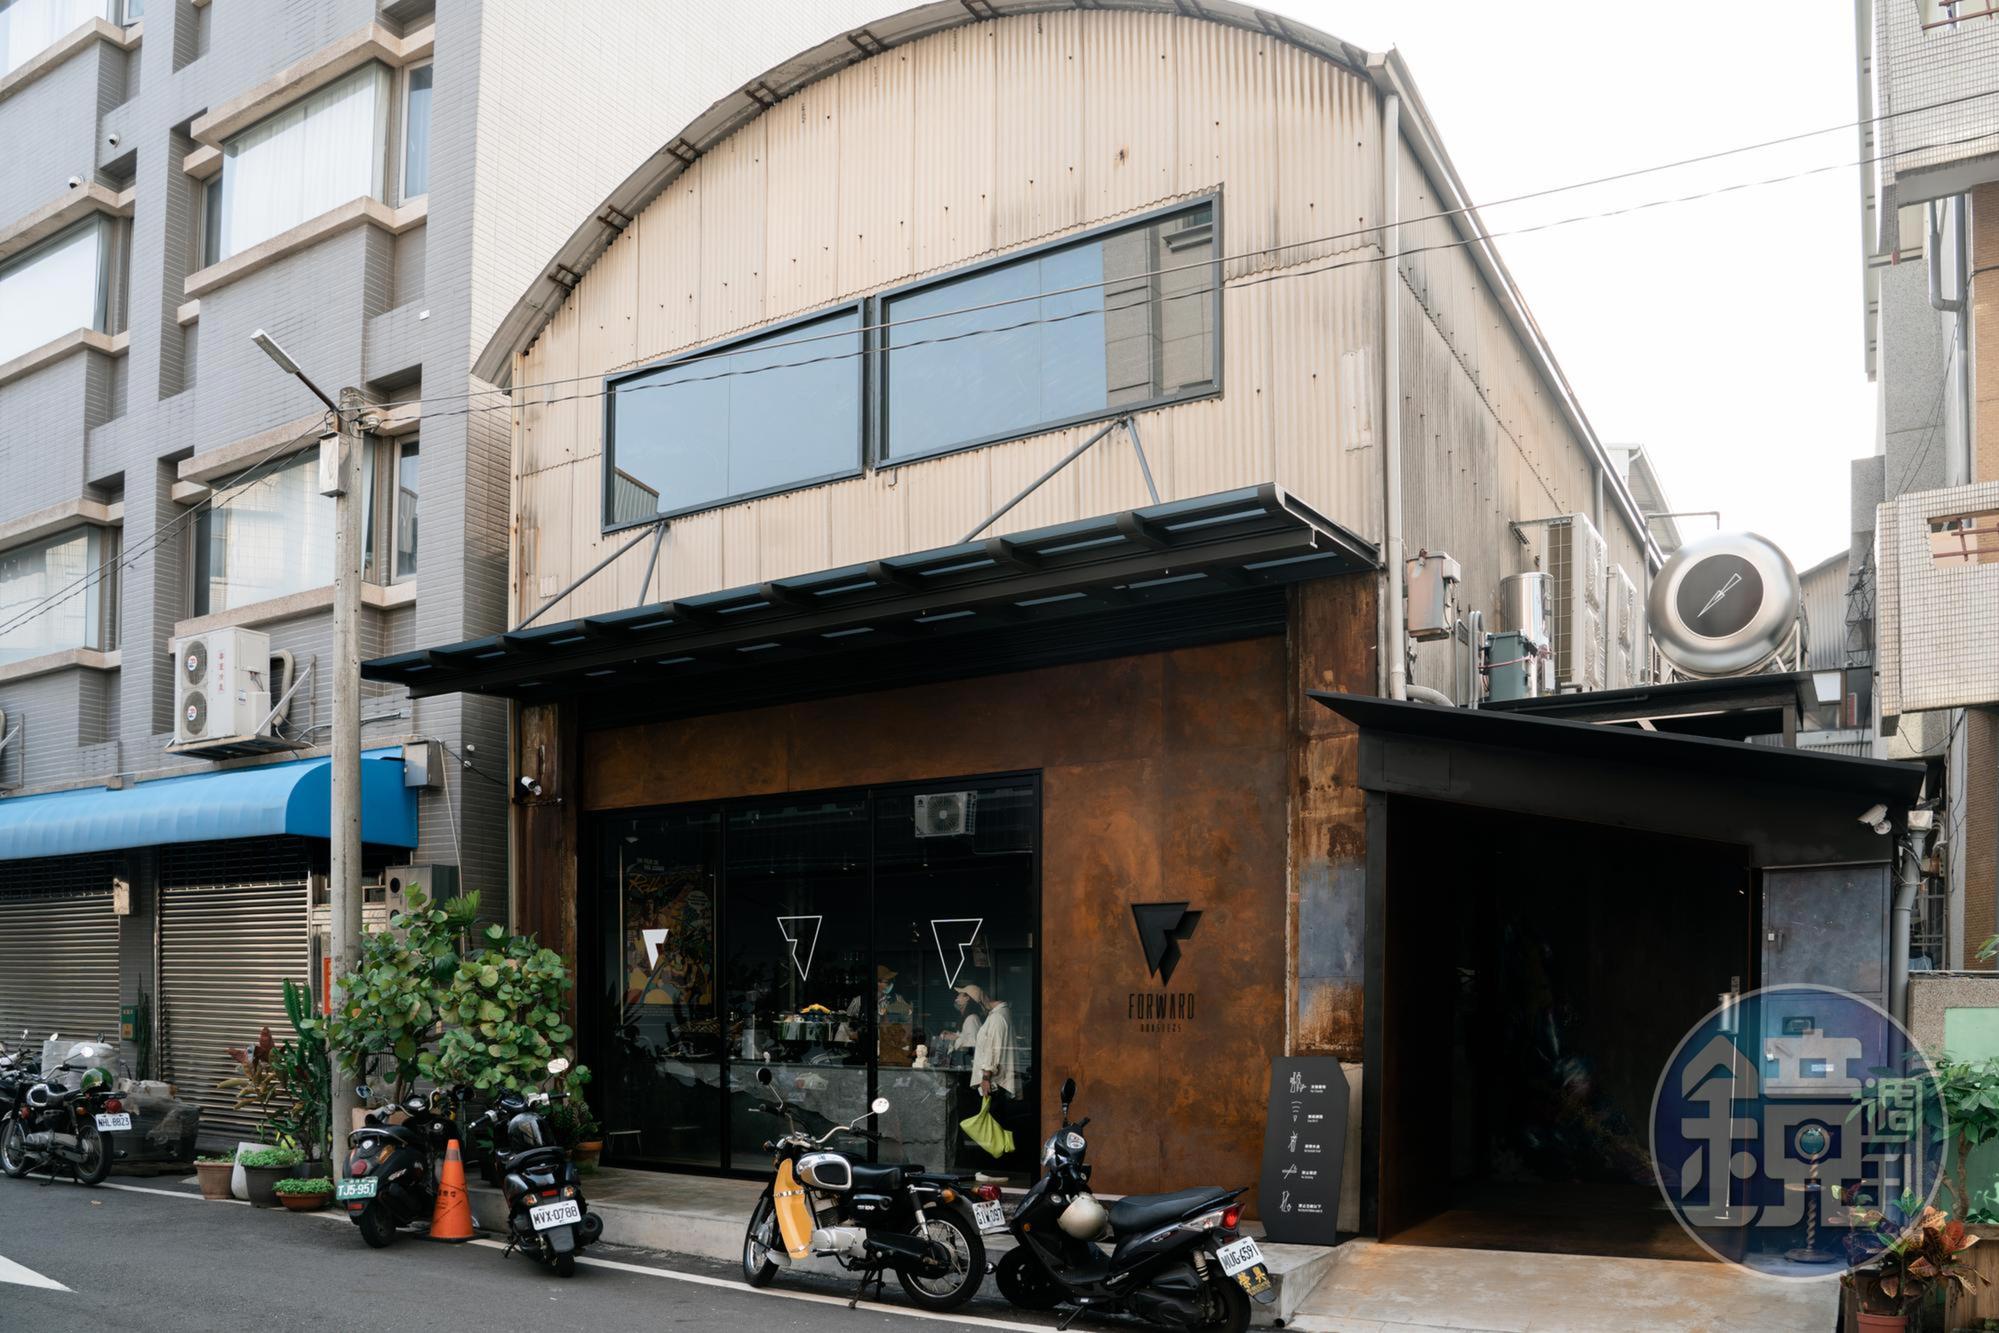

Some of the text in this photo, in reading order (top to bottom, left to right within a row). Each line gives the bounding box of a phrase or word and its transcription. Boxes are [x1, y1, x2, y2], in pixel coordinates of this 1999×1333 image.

[1128, 992, 1194, 1019] FORWARD
[532, 1205, 578, 1225] MVX-0788
[1220, 1243, 1259, 1270] MUG-6591
